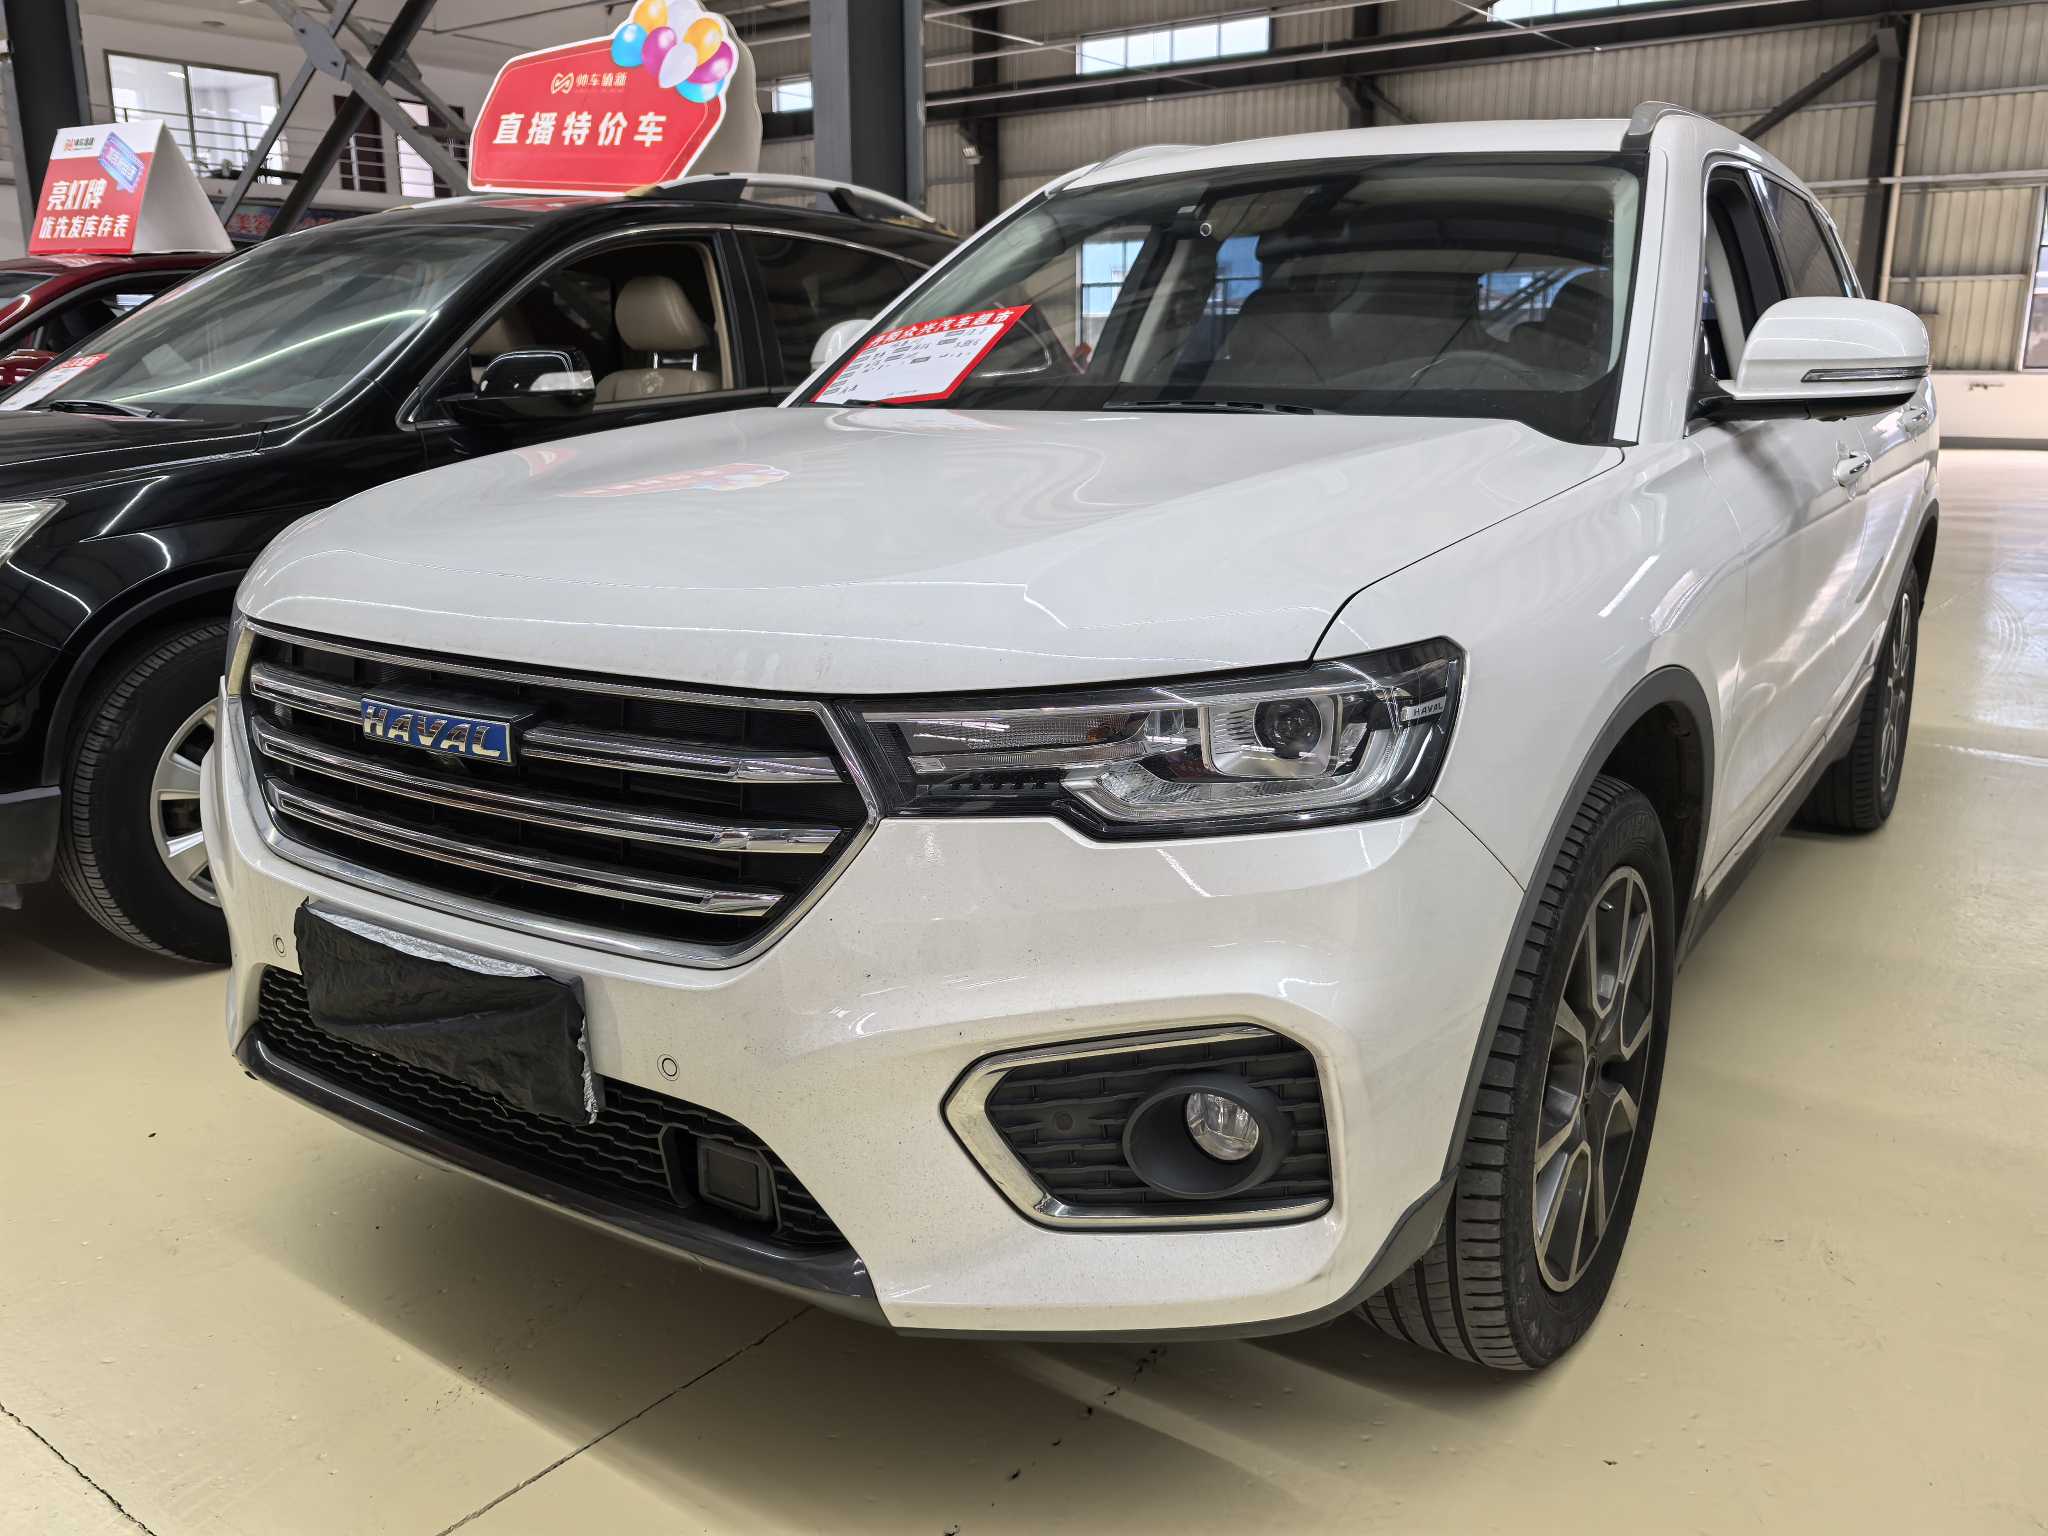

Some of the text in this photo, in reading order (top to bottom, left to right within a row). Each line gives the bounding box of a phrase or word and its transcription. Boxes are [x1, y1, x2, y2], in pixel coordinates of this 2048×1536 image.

[492, 111, 668, 147] 直播特价车
[46, 178, 108, 211] 亮灯牌
[1413, 702, 1443, 716] HAVAL
[363, 706, 501, 757] HAVAL
